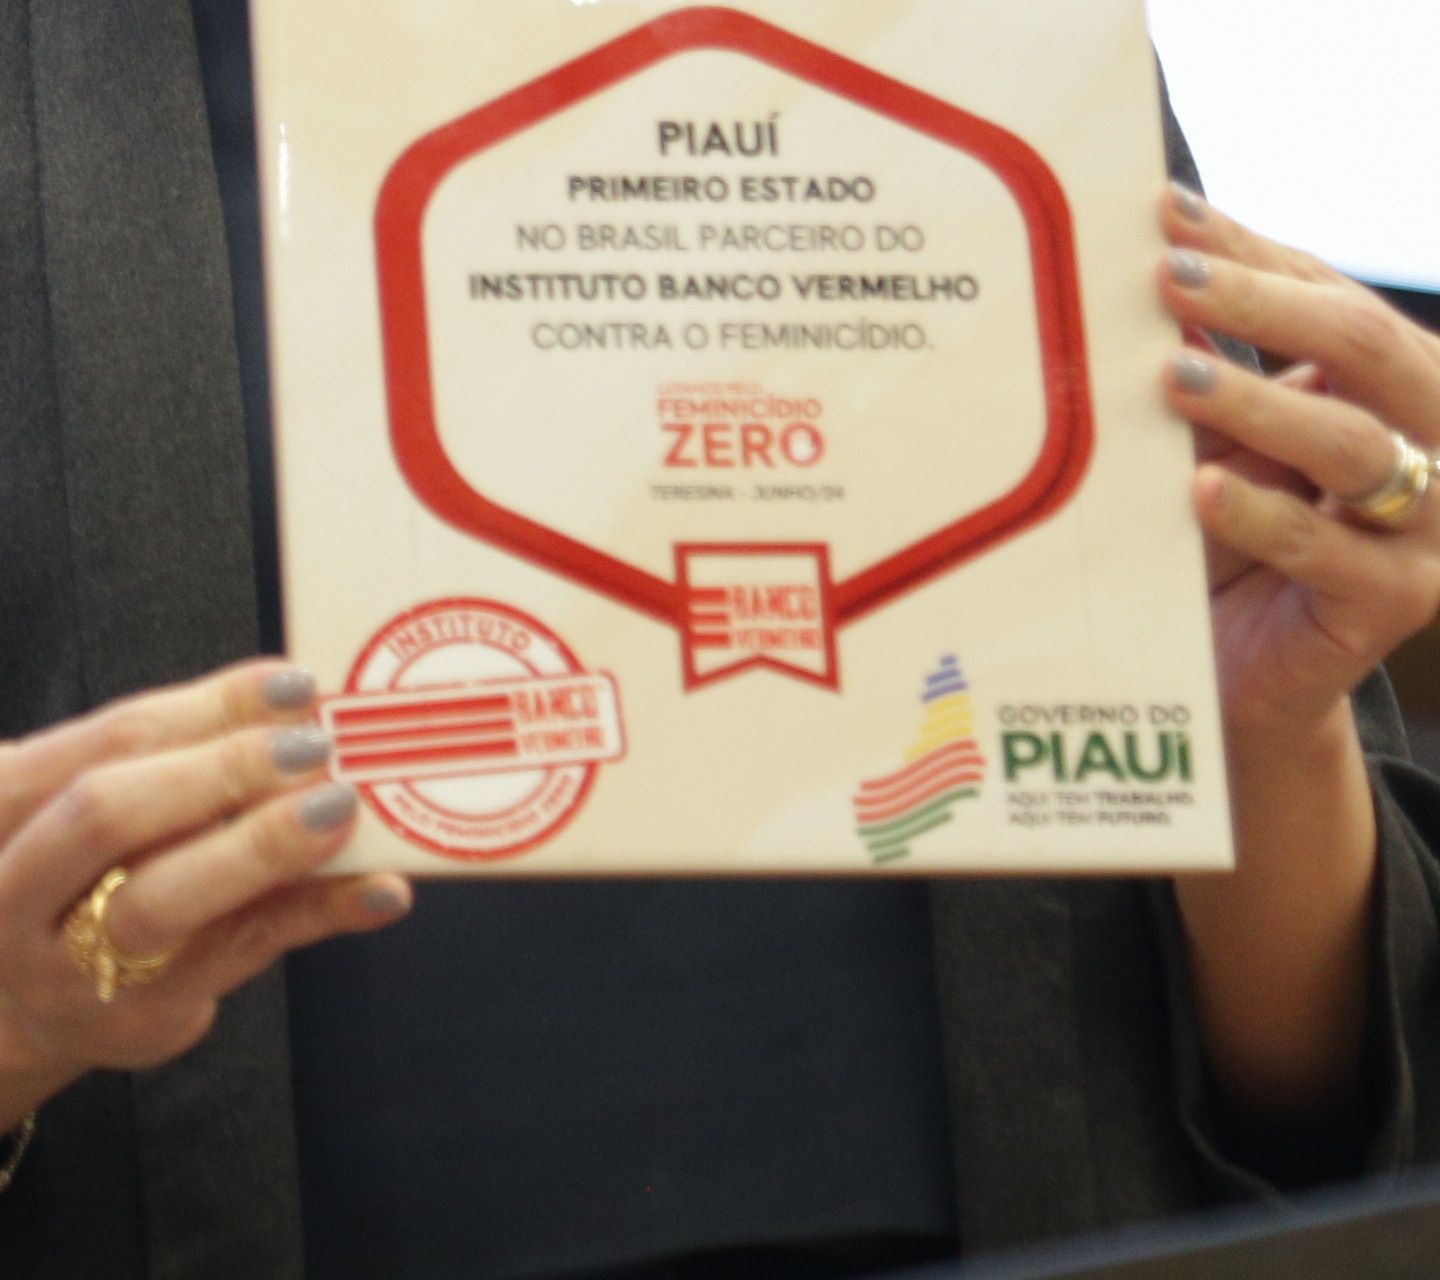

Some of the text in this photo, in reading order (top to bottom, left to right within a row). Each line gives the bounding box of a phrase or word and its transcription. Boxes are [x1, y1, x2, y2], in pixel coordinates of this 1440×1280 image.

[657, 113, 781, 157] PIAUÍ
[568, 175, 876, 203] PRIMEIRO ESTADO
[515, 224, 926, 253] NO BRASIL PARCEIRO DO
[468, 273, 980, 302] INSTITUTO BANCO VERMELHO
[532, 316, 935, 352] CONTRA O FEMINICÍDIO.
[660, 422, 826, 468] ZERO
[389, 612, 532, 659] INSTITUTO
[999, 704, 1191, 724] GOVERNO DO
